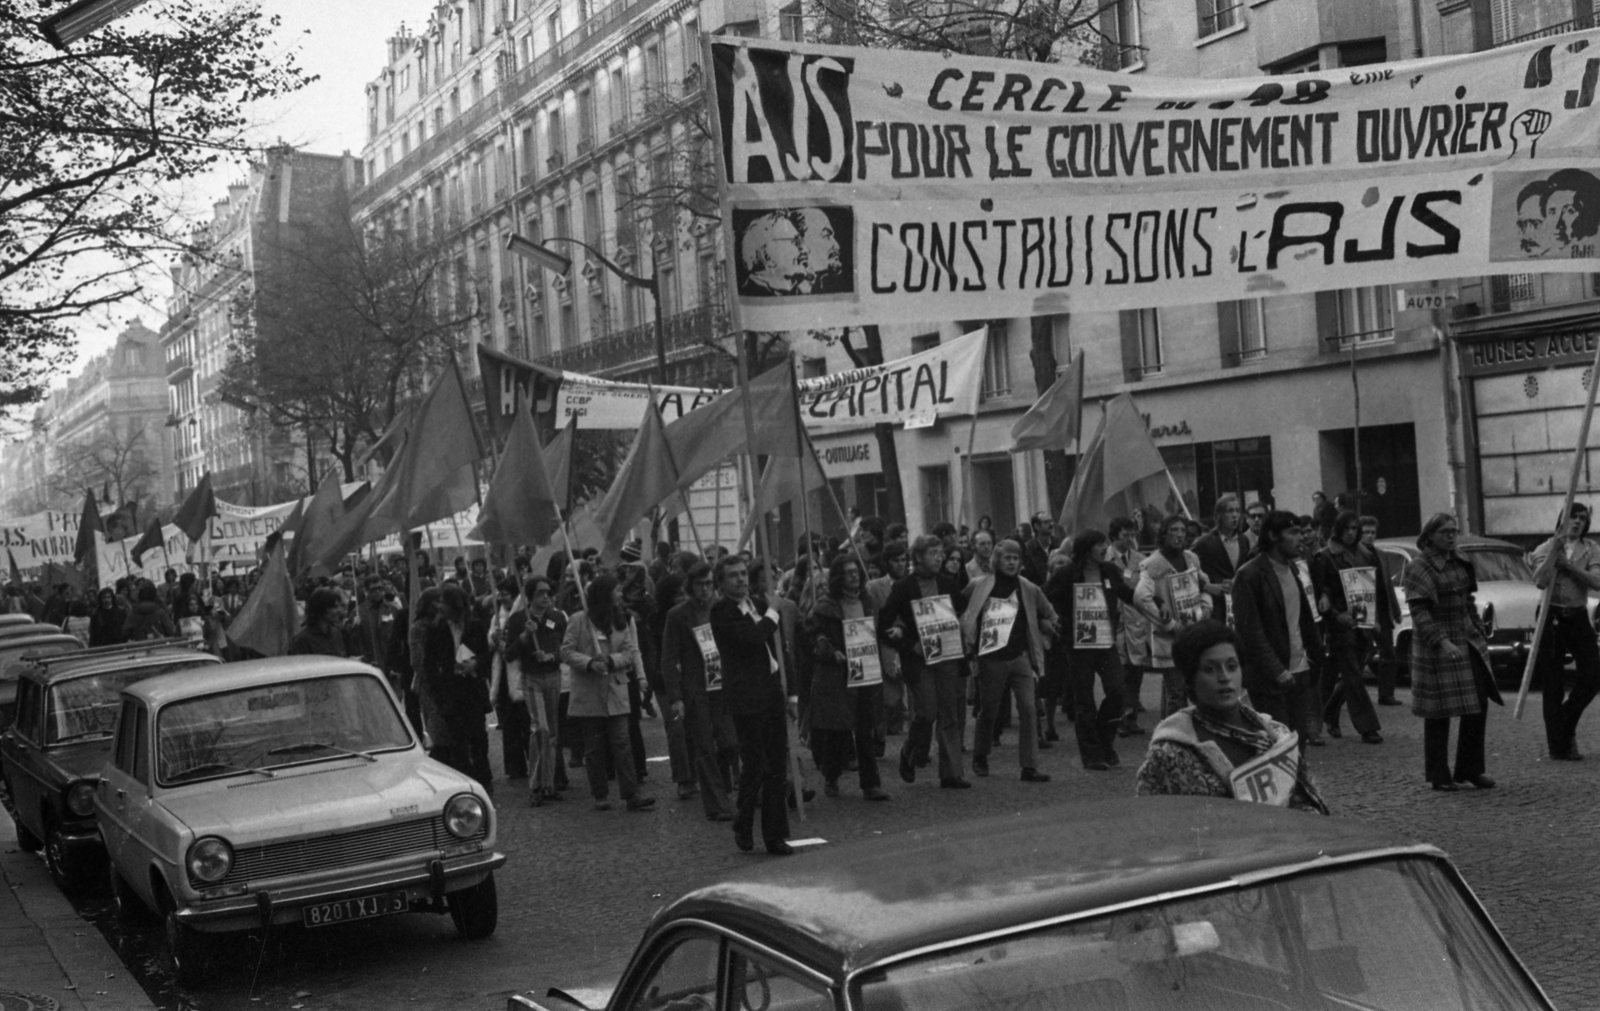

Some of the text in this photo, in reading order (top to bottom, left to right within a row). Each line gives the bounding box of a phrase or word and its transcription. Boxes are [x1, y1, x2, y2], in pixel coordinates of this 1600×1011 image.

[927, 68, 1133, 112] CERCLE
[732, 45, 846, 182] AJS
[857, 101, 1508, 180] POUR LE GOUVERNEMENT OUVRIER
[871, 207, 1218, 294] CONSTRUISONS
[1405, 295, 1442, 309] AUTO
[1473, 340, 1537, 367] HUILES
[809, 361, 954, 418] CAPITAL
[915, 600, 936, 617] JR
[1078, 587, 1097, 601] JR
[310, 902, 353, 924] 8201
[357, 897, 378, 917] XJ
